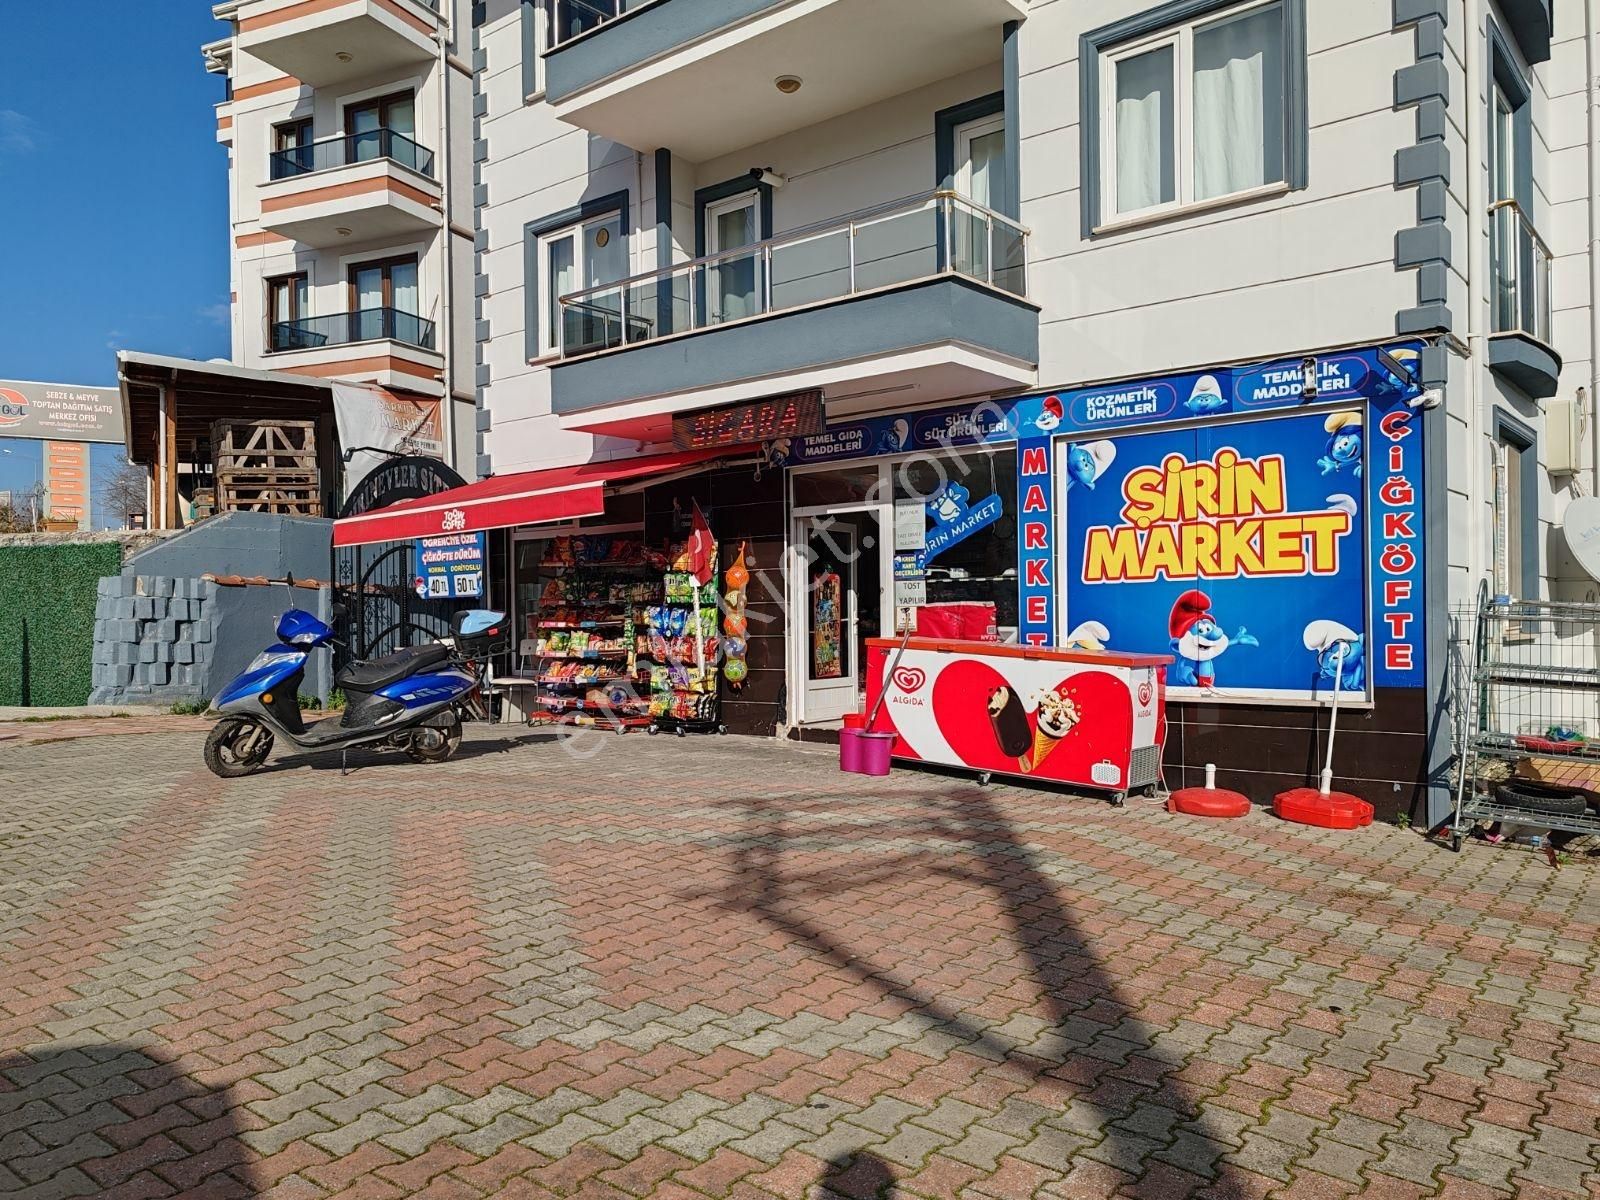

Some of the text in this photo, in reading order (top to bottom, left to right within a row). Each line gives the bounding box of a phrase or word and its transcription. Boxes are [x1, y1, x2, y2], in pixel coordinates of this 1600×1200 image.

[1262, 361, 1340, 385] TEMİLİK
[1253, 373, 1350, 400] MADDLERİ
[46, 390, 100, 402] SEBZE & MEYVE
[1086, 387, 1157, 408] KOZMETİK
[32, 400, 61, 410] TOPTAN
[1086, 398, 1157, 421] ÜRÜNLERİ
[48, 411, 78, 421] MERKEZ
[945, 412, 967, 426] SÜT
[804, 430, 864, 446] TEMEL GIDA
[924, 427, 947, 441] SÜT
[805, 438, 862, 457] MADDELERİ
[1123, 448, 1284, 530] ŞİRİN
[441, 519, 466, 531] COFFEE
[951, 502, 995, 538] MARKET
[1021, 447, 1050, 649] MARKET
[1083, 512, 1350, 582] MARKET
[1379, 410, 1416, 671] ÇİĞKÖFTE
[454, 546, 481, 561] DÜRÜM
[431, 579, 448, 594] 40 TL
[457, 577, 476, 593] 50 TL
[903, 582, 921, 590] TOST
[899, 596, 926, 605] YAPILIR
